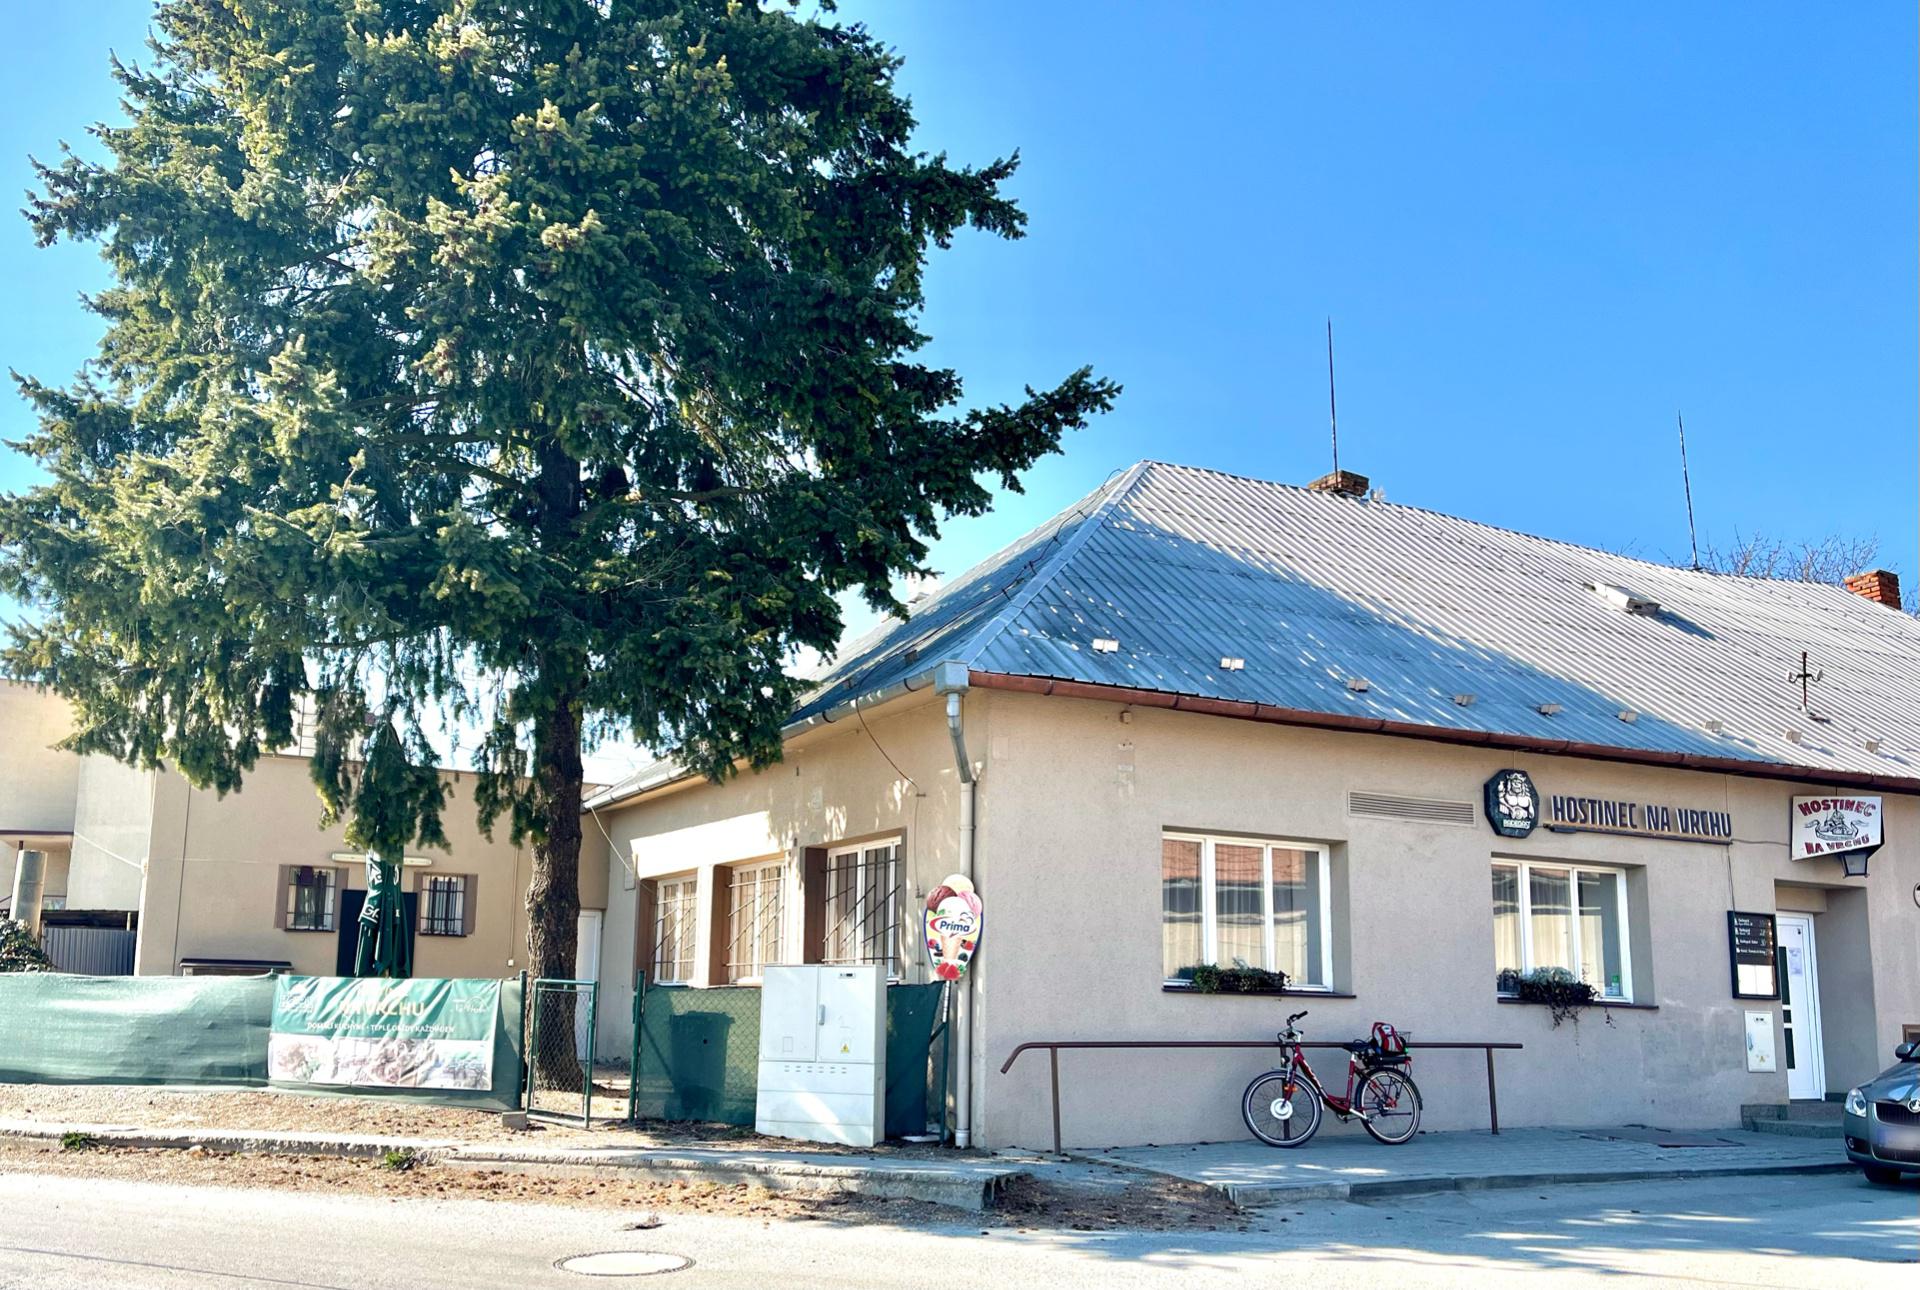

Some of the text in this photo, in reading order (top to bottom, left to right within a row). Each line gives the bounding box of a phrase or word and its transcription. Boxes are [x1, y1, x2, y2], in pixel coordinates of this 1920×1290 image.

[1552, 795, 1732, 838] HOSTINEC NA VRCHU
[1798, 798, 1877, 817] HOSTINEC
[1804, 834, 1870, 855] NA VRCHU
[939, 920, 971, 932] Prima
[364, 1001, 425, 1017] VRCHU
